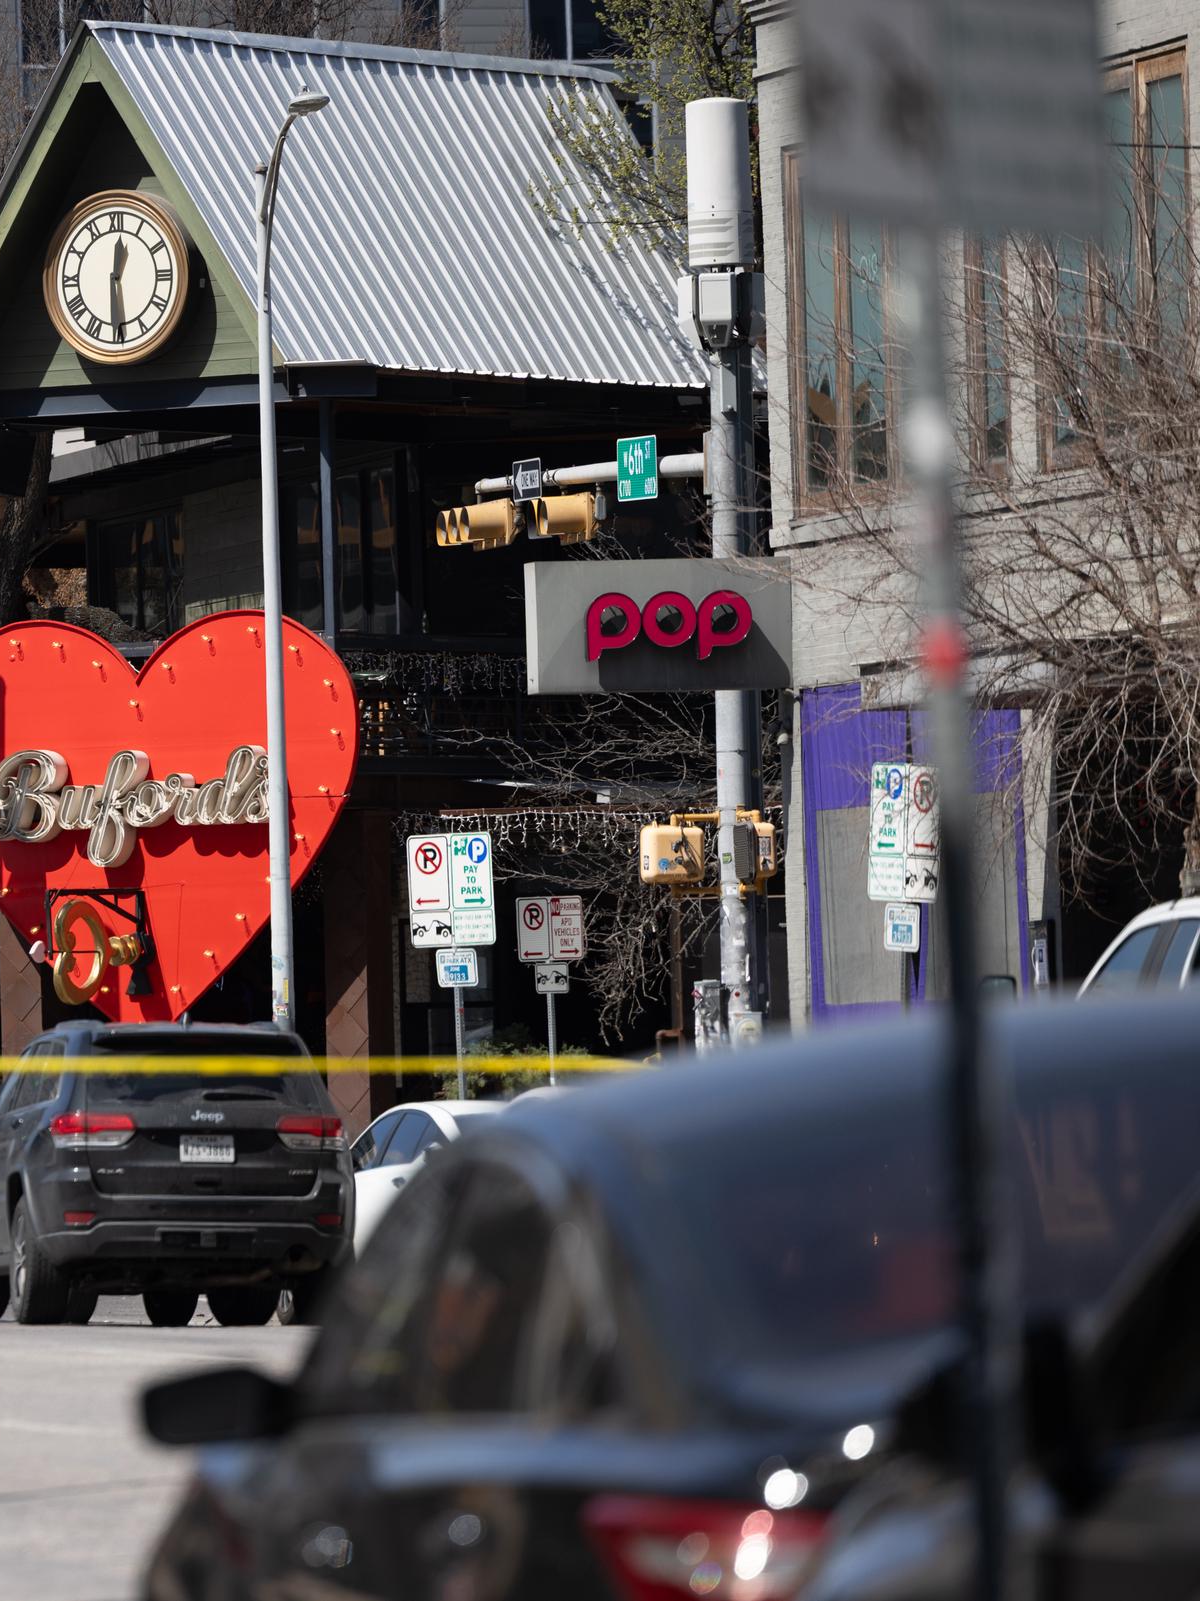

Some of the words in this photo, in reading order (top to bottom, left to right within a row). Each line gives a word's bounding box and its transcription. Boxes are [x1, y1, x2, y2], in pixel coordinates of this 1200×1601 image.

[628, 442, 644, 476] 6th
[521, 472, 529, 488] ONE
[529, 471, 538, 487] WAY
[882, 801, 896, 812] PAY
[884, 814, 893, 824] TO
[879, 827, 897, 838] PARK
[463, 865, 479, 874] PAY
[466, 875, 476, 884] TO
[461, 886, 483, 895] PARK
[551, 902, 560, 914] NO
[560, 902, 580, 911] PARKING
[554, 927, 580, 936] VEHICLES
[560, 938, 574, 947] ONLY
[190, 1109, 225, 1124] Jeep
